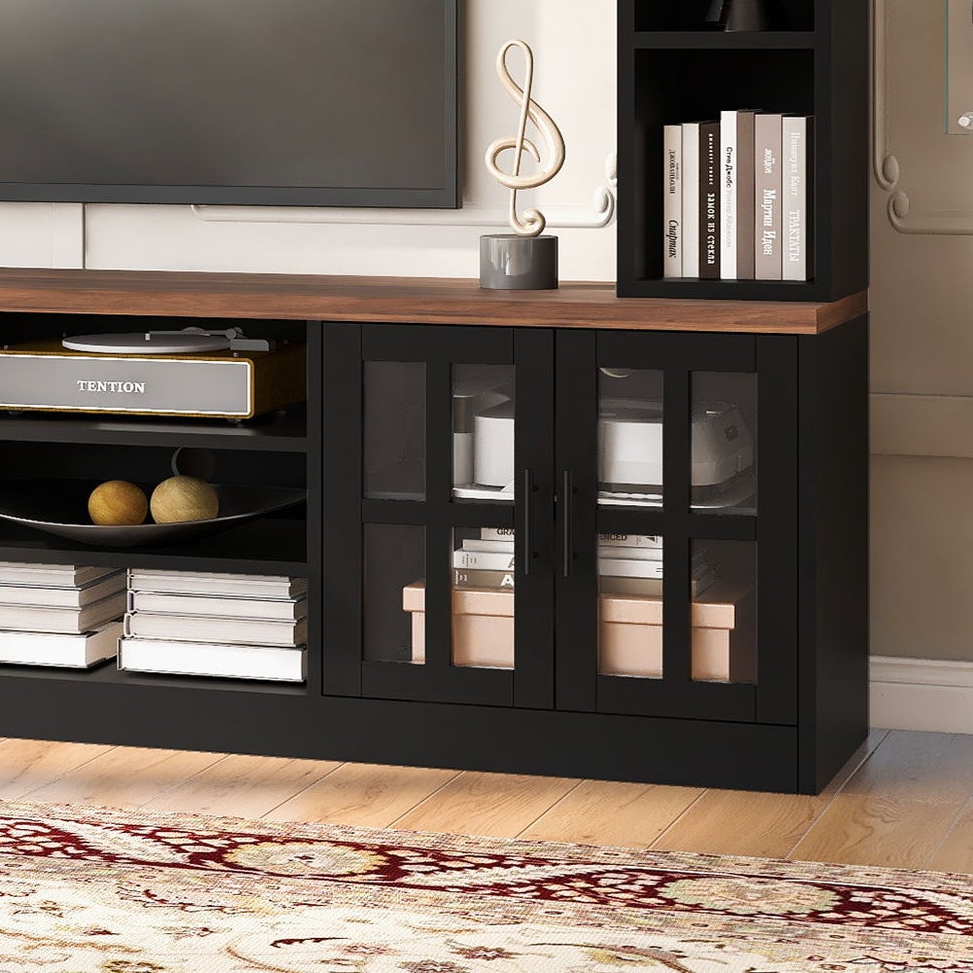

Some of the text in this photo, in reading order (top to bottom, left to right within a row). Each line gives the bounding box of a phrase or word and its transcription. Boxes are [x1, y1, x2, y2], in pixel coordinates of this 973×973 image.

[725, 147, 733, 164] Стив
[725, 164, 734, 188] Джобс
[762, 189, 776, 226] Мартин
[666, 220, 679, 258] Спартак
[762, 230, 777, 256] Иден
[789, 209, 800, 262] ТРАКТАТЫ
[77, 379, 146, 394] TENTION
